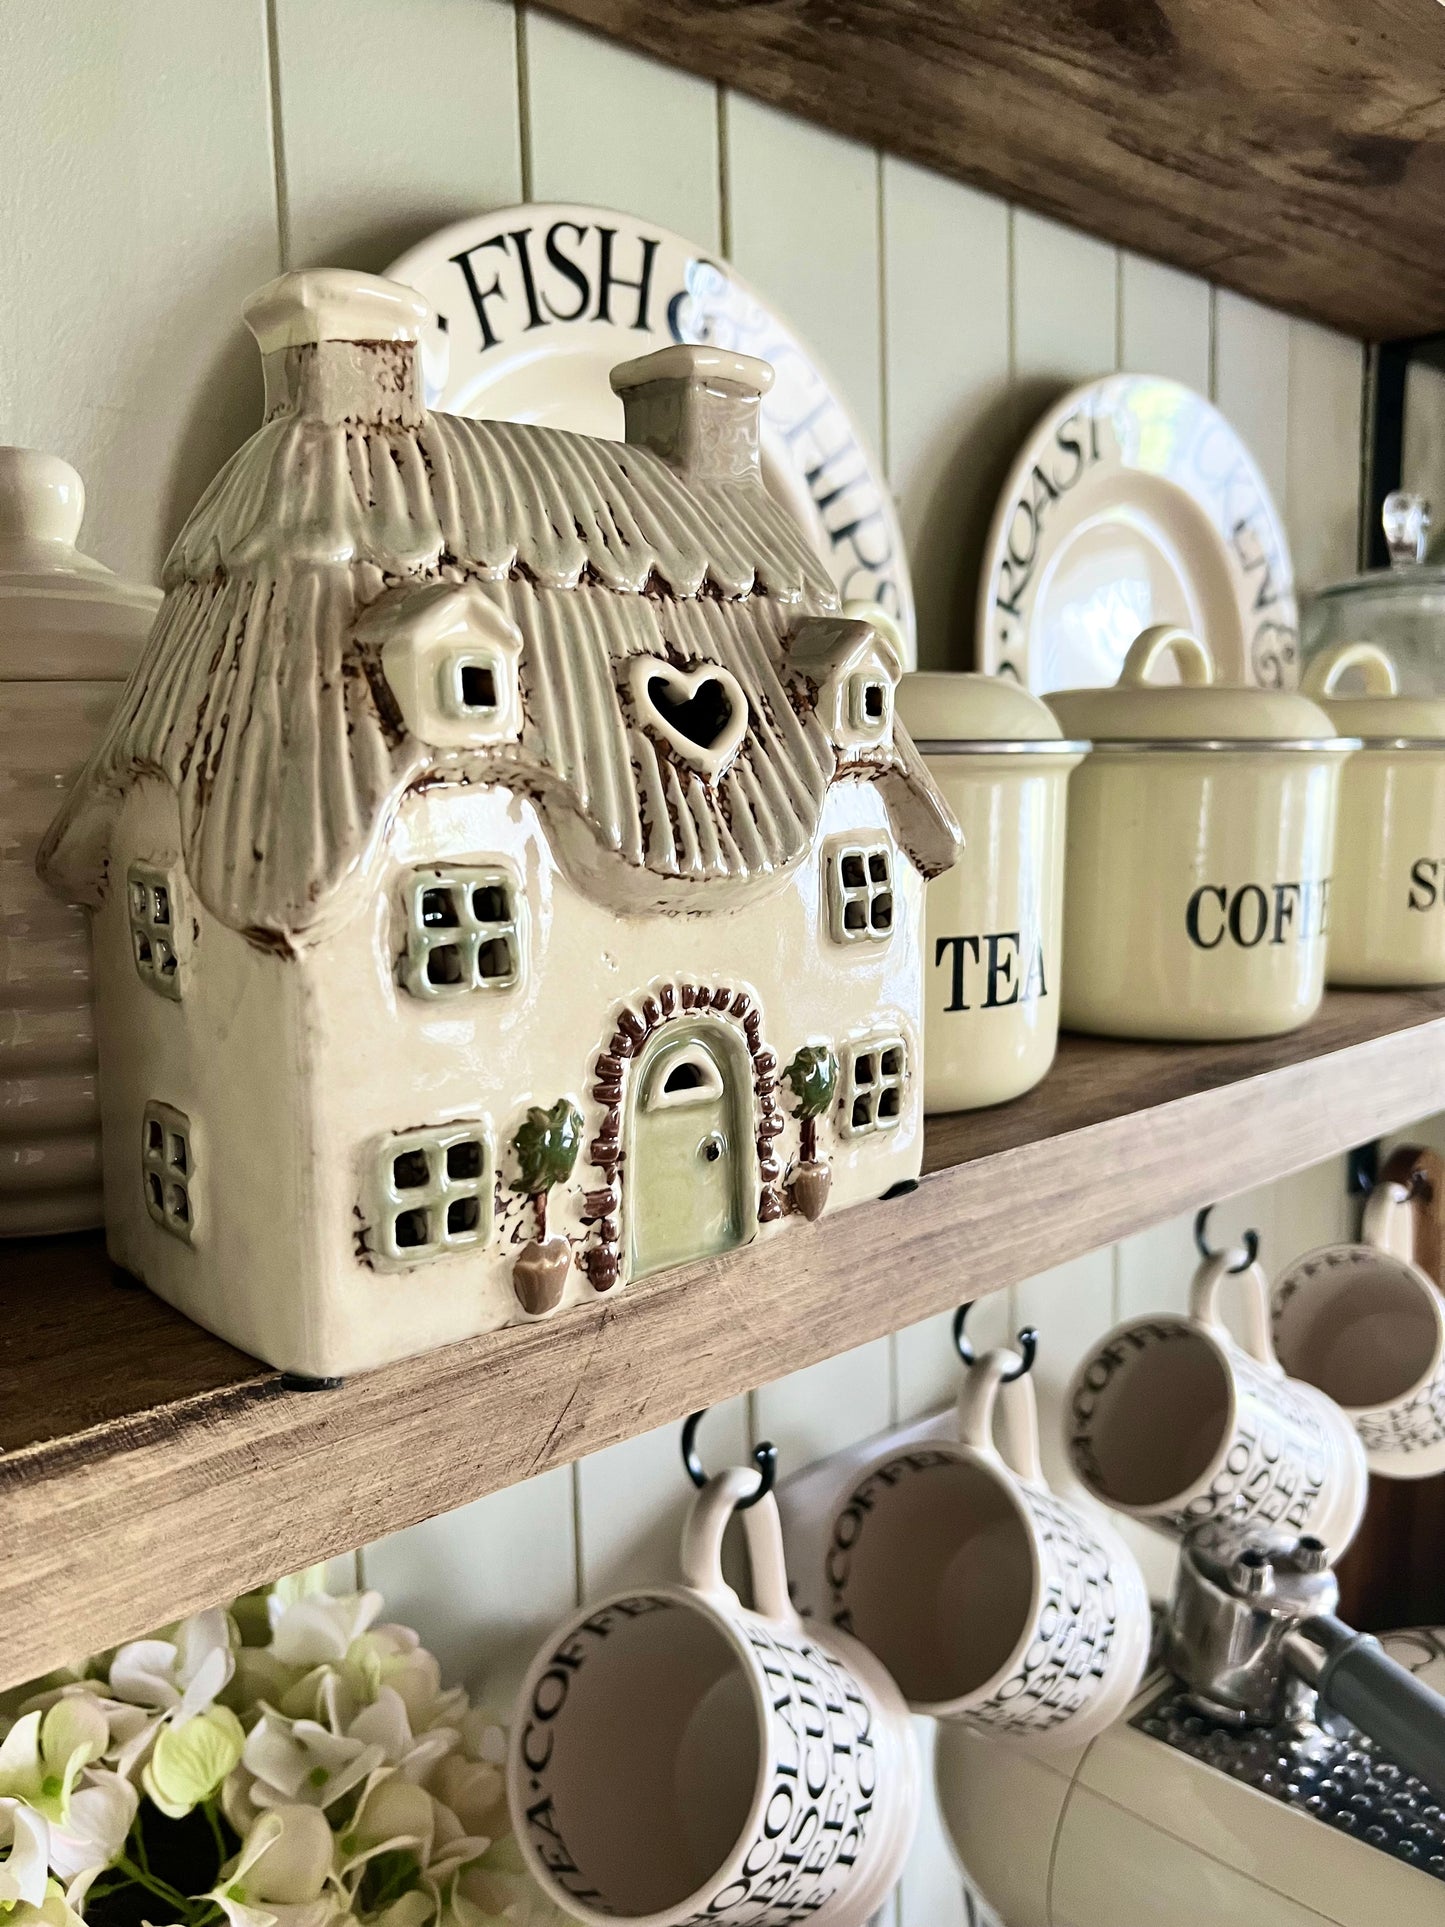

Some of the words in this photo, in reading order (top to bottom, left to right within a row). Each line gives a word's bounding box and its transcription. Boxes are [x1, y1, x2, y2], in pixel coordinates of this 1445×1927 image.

[450, 221, 661, 352] FISH
[1408, 857, 1445, 912] S
[935, 932, 1047, 1012] TEA
[526, 1794, 612, 1912] TEA
